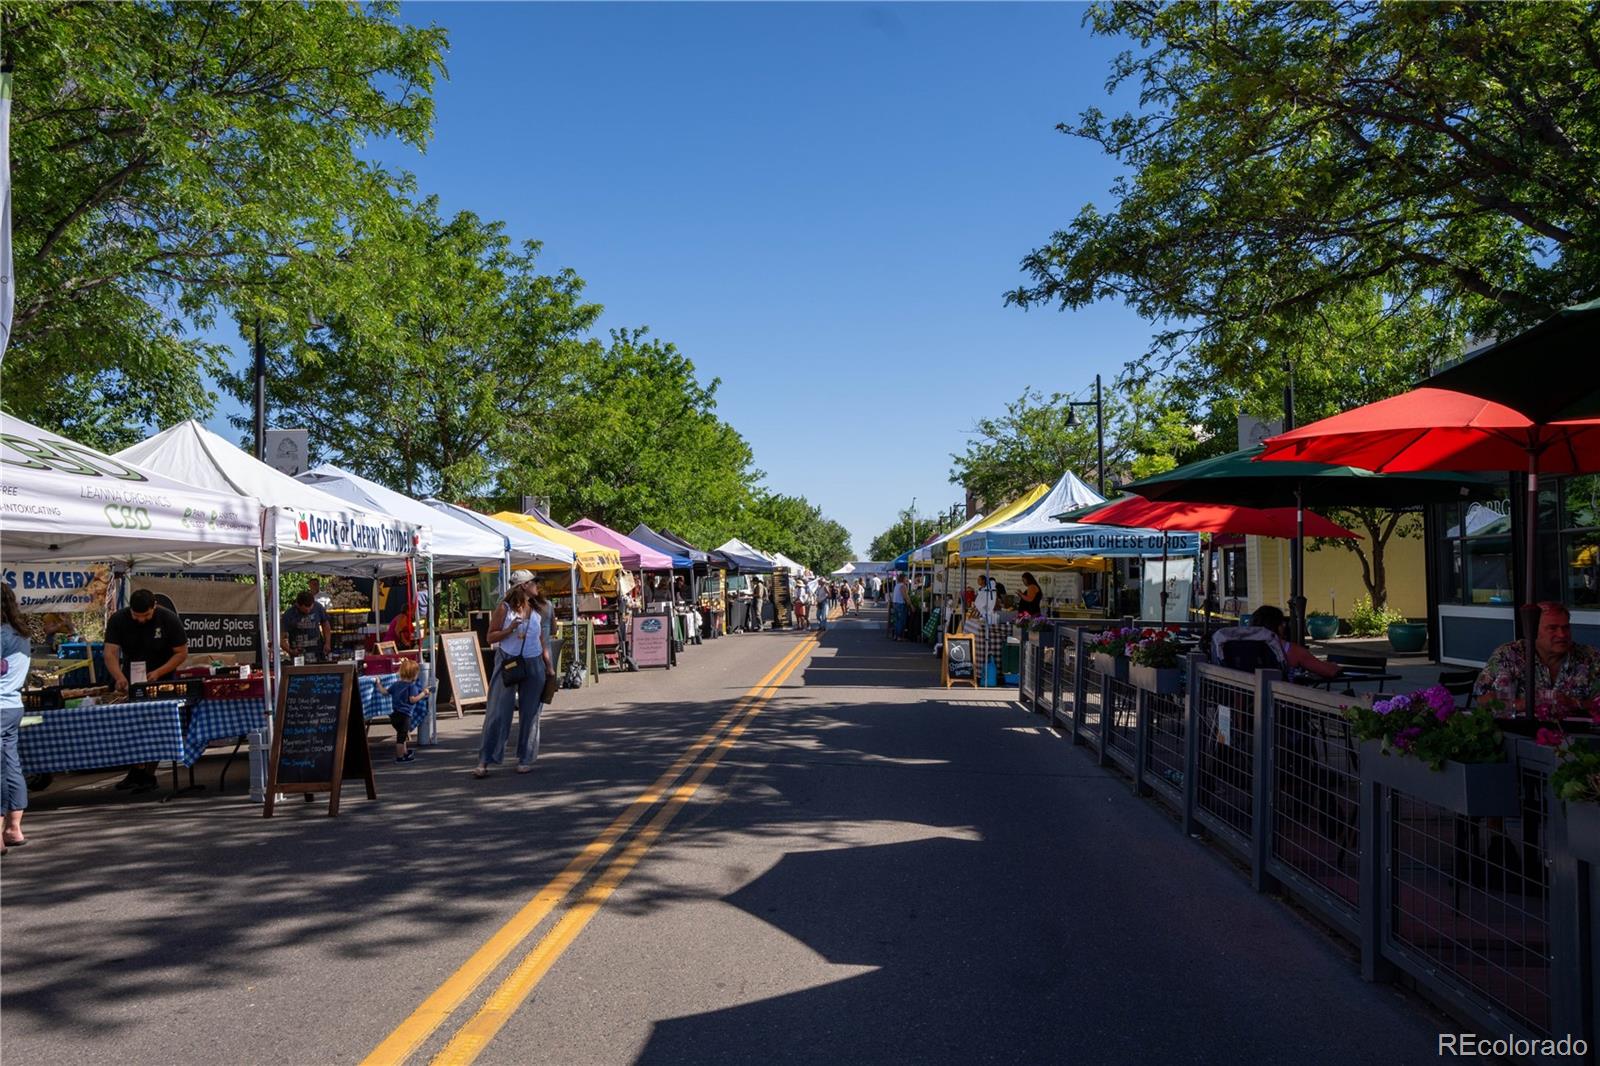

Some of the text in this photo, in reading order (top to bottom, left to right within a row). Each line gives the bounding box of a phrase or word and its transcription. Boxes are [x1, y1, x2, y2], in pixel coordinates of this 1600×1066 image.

[0, 503, 62, 517] -INTOXICATING
[104, 503, 152, 530] CBD
[309, 514, 338, 546] APPLE
[339, 522, 350, 545] or
[350, 518, 380, 550] CHERRY
[1027, 534, 1187, 549] WISCONSIN CHEESE CURDS
[23, 571, 95, 589] BAKERY
[183, 618, 254, 632] Smoked Spices
[186, 633, 253, 650] and Dry Rubs
